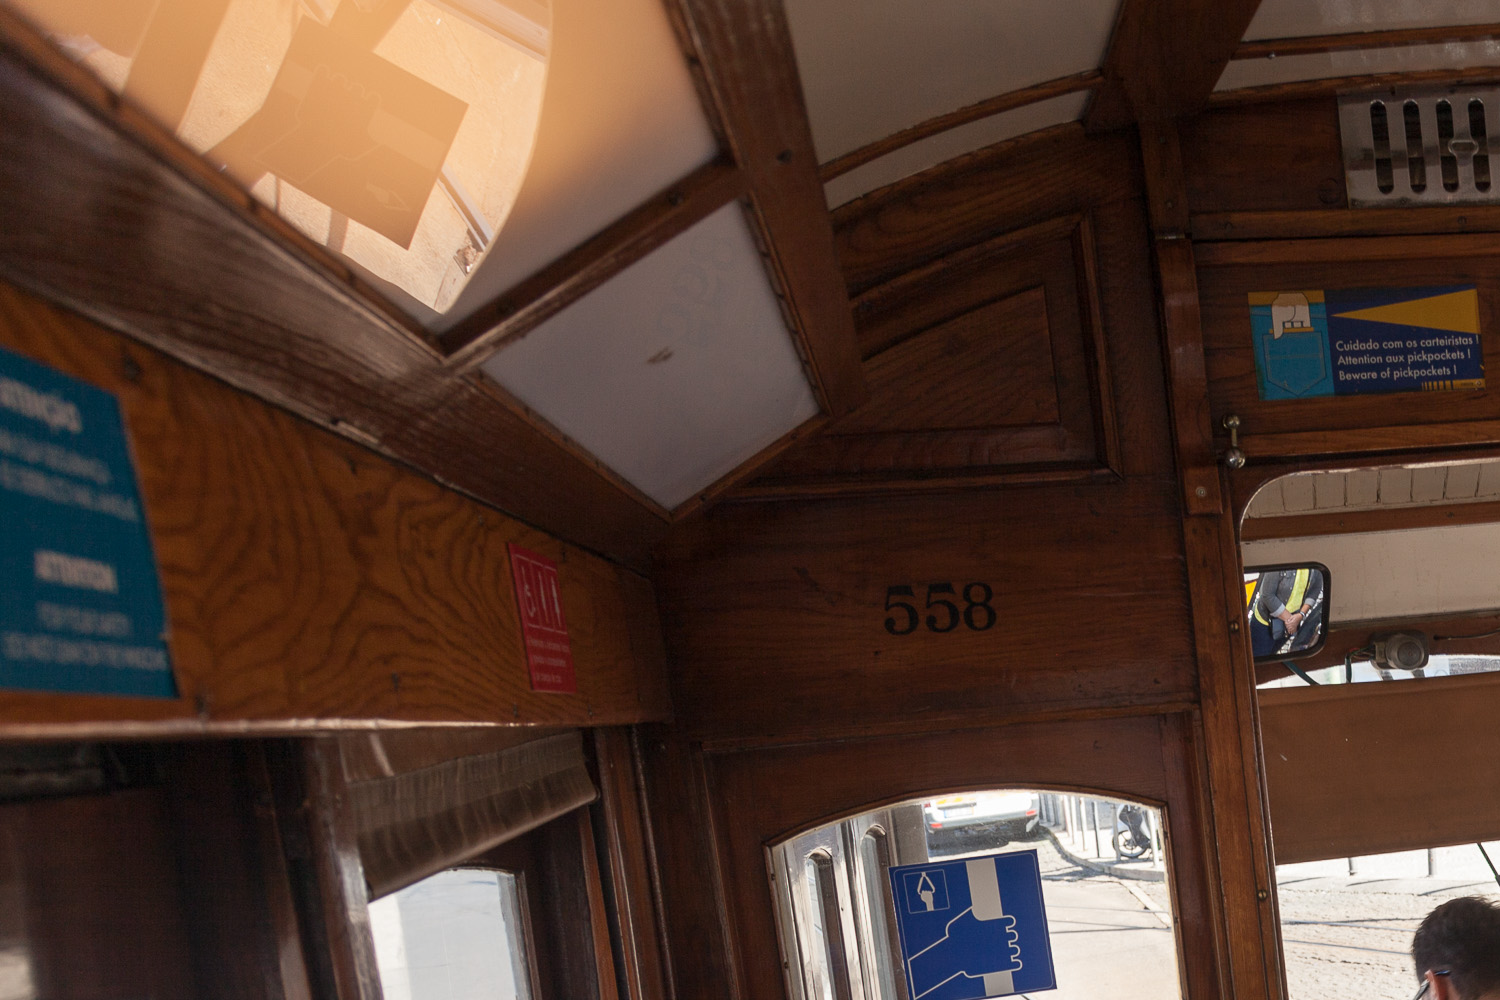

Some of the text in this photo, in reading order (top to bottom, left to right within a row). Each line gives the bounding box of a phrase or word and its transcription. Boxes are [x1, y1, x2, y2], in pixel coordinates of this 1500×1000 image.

[1336, 339, 1379, 351] Cuidado
[1382, 341, 1403, 349] com
[1406, 340, 1418, 348] os
[1420, 336, 1472, 347] carteiristas
[1338, 354, 1382, 365] Attention
[1386, 354, 1404, 362] aux
[1408, 349, 1464, 364] pickpockets
[1339, 370, 1378, 380] Beware
[1380, 367, 1390, 378] of
[1394, 365, 1450, 380] pickpockets
[884, 582, 997, 636] 558
